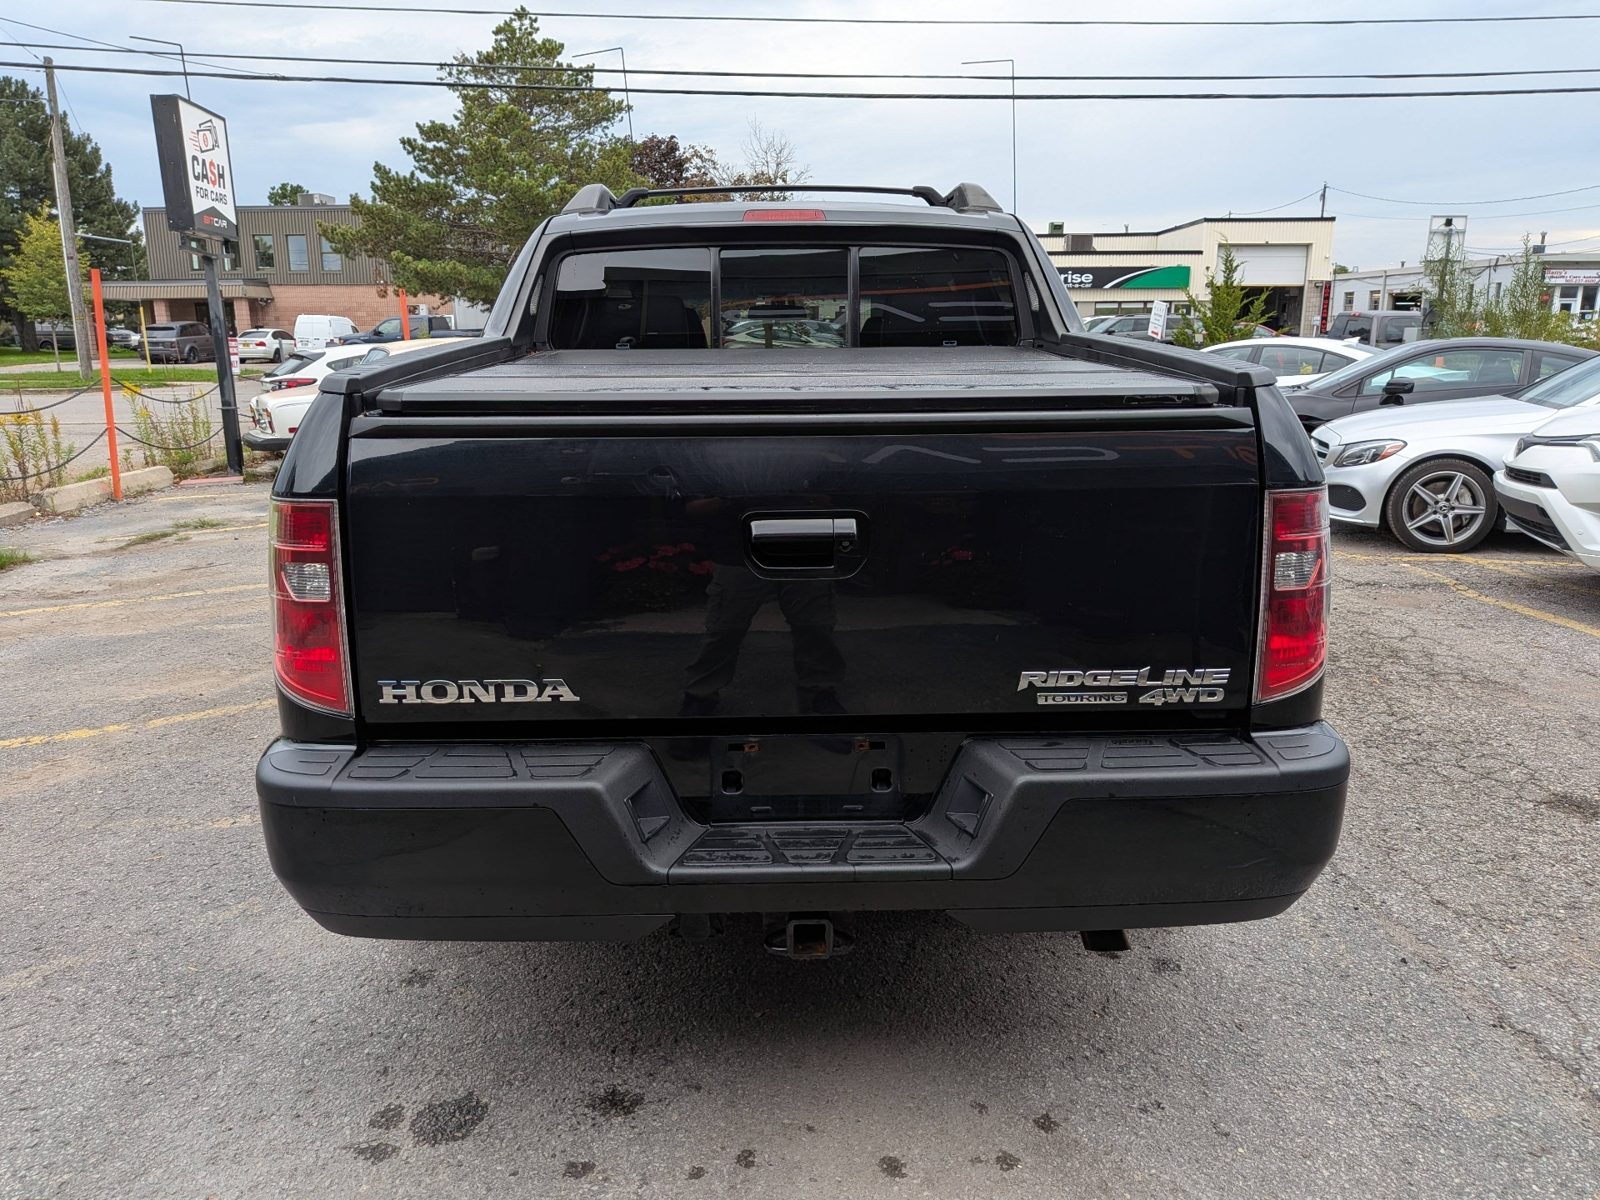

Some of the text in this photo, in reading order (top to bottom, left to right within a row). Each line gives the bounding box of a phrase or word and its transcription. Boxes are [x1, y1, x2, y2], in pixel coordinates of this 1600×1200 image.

[195, 185, 228, 206] FOR CARS
[1017, 666, 1231, 692] RIDGELINE
[377, 678, 580, 704] HONDA
[1040, 687, 1224, 706] TOURING 4WD
